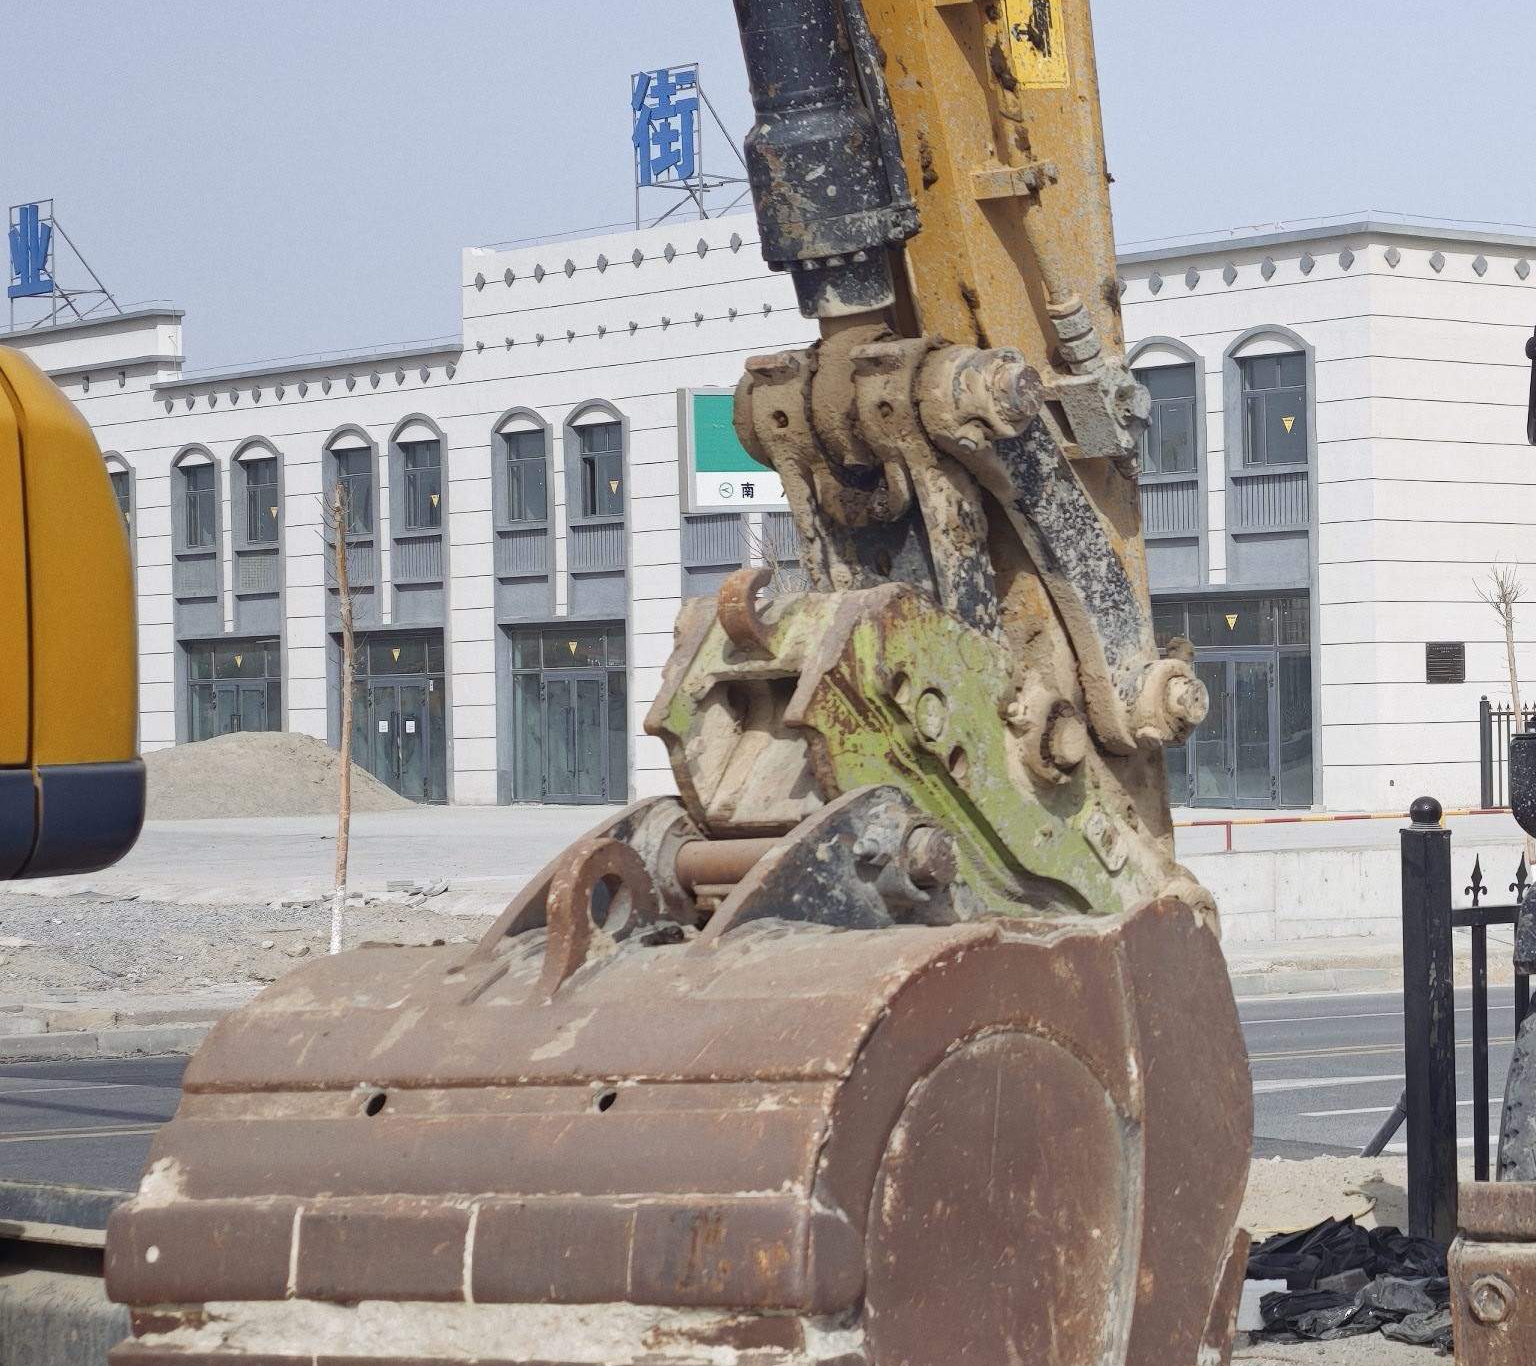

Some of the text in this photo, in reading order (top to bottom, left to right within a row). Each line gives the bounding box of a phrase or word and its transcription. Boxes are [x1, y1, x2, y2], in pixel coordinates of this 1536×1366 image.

[631, 69, 698, 186] 街
[8, 205, 53, 298] 业
[741, 482, 755, 498] 南
